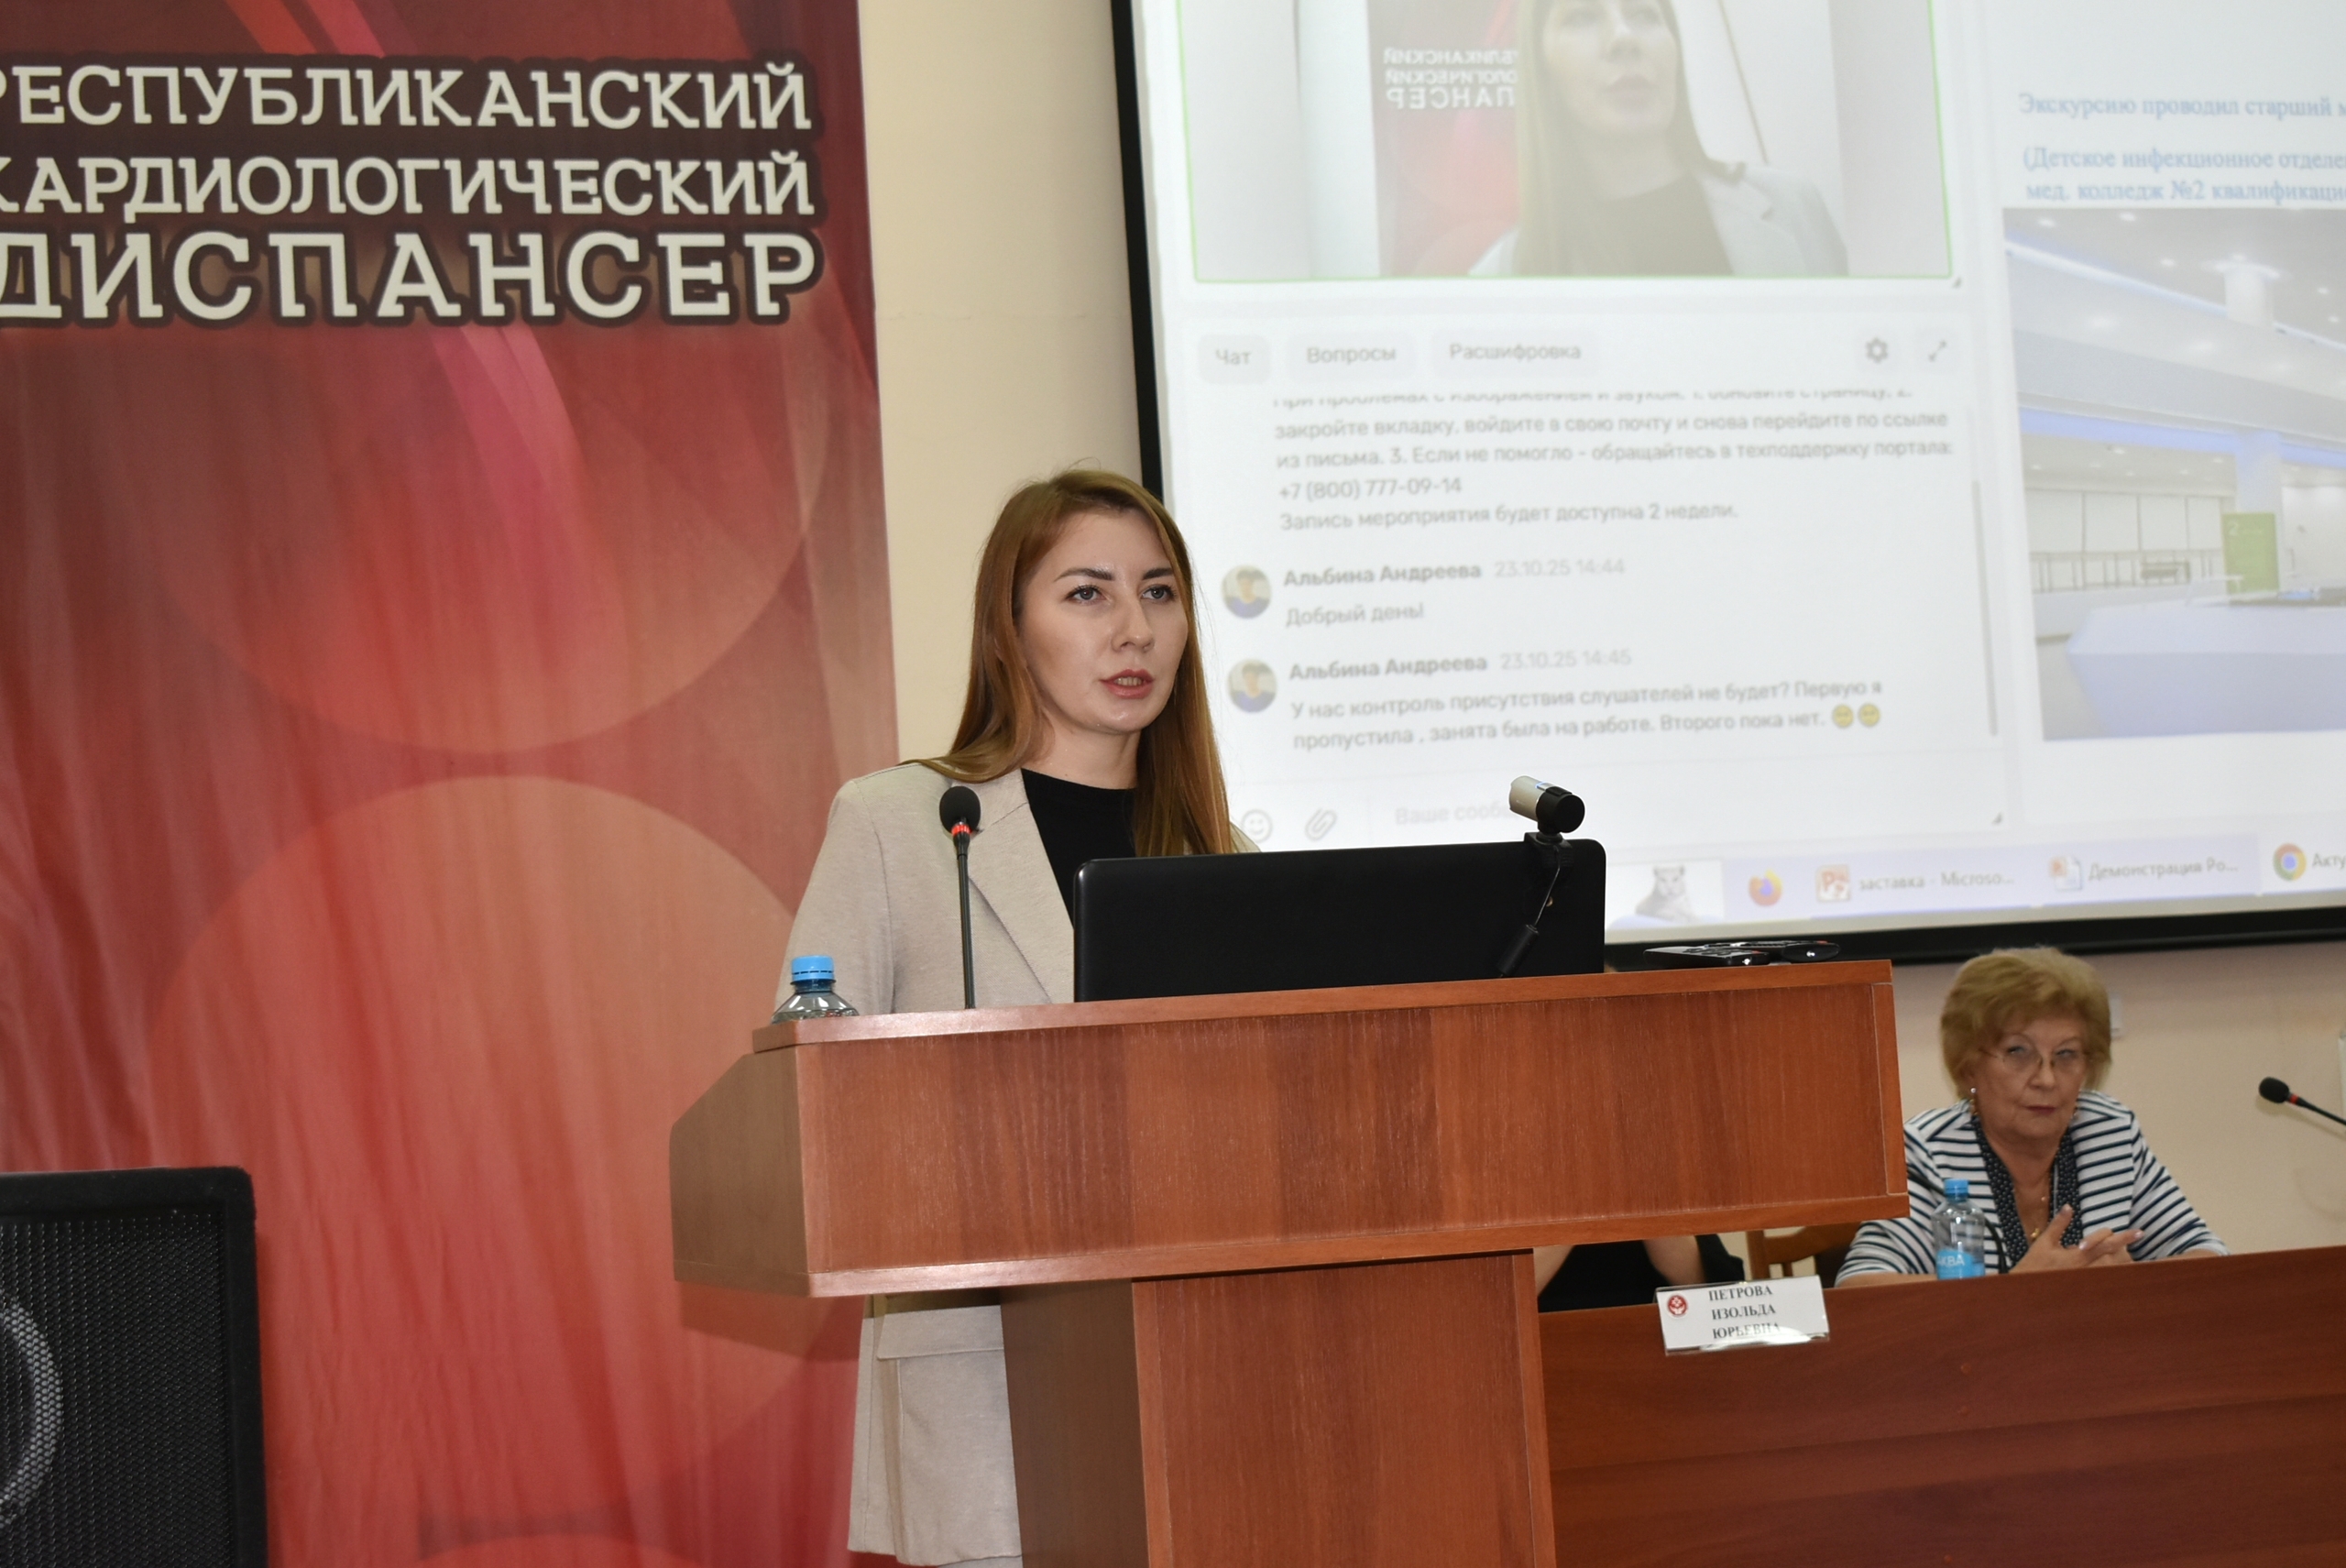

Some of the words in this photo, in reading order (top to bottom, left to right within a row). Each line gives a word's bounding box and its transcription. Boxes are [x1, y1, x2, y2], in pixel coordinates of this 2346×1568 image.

[0, 62, 812, 130] ЕСПУБЛИКАНСКИЙ
[2019, 93, 2136, 119] Экскурсию
[2142, 98, 2239, 120] проводил
[2245, 96, 2332, 121] старший
[2023, 147, 2115, 172] (Детское
[2122, 148, 2273, 173] инфекционное
[2279, 151, 2346, 170] отделе
[2026, 184, 2070, 201] мед.
[2077, 184, 2164, 201] колледж
[2171, 179, 2205, 200] №2
[0, 231, 815, 321] ДИСПАНСЕР
[1215, 349, 1251, 366] Чат
[1307, 346, 1397, 365] Вопросы
[1450, 343, 1582, 362] Расшифровка
[1276, 419, 1368, 441] закройте
[1465, 415, 1544, 435] войдите
[1550, 419, 1561, 432] в
[1564, 418, 1613, 432] свою
[1618, 417, 1672, 434] почту
[1677, 417, 1688, 430] и
[1694, 416, 1748, 431] снова
[1753, 411, 1852, 432] перейдите
[1858, 414, 1878, 428] по
[1883, 412, 1948, 428] ссылке
[1277, 455, 1299, 468] из
[1305, 451, 1384, 468] письма.
[1390, 447, 1408, 465] 3.
[1412, 446, 1460, 464] Если
[1465, 448, 1487, 462] не
[1494, 446, 1573, 462] помогло
[1592, 443, 1716, 462] обращайтесь
[1720, 445, 1731, 458] в
[1737, 444, 1869, 460] техподдержку
[1278, 484, 1300, 499] +7
[1306, 480, 1362, 501] (800)
[1365, 477, 1463, 496] 777-09-14
[1280, 511, 1354, 532] Запись
[1358, 508, 1490, 530] мероприятия
[1496, 504, 1550, 525] будет
[1556, 503, 1644, 523] доступна
[1649, 503, 1661, 520] 2
[1665, 503, 1738, 521] недели.
[1284, 569, 1375, 587] Альбина
[1380, 563, 1482, 585] Андреева
[1494, 560, 1571, 578] 23.10.25
[1576, 558, 1626, 576] 14:44
[1286, 605, 1365, 629] Добрый
[1289, 663, 1380, 681] Альбина
[1385, 655, 1487, 677] Андреева
[1500, 652, 1577, 671] 23.10.25
[1583, 649, 1632, 666] 14:45
[1291, 702, 1304, 719] У
[1310, 704, 1344, 718] нас
[1351, 696, 1445, 716] контроль
[1450, 692, 1574, 712] присутствия
[1580, 684, 1694, 706] слушателей
[1699, 686, 1720, 701] не
[1726, 680, 1789, 702] будет?
[1795, 681, 1867, 700] Первую
[1872, 682, 1882, 695] я
[1294, 728, 1413, 751] пропустила
[1429, 727, 1496, 743] занята
[1502, 721, 1550, 740] была
[1555, 722, 1578, 736] на
[1584, 715, 1655, 737] работе.
[1661, 713, 1735, 732] Второго
[1740, 715, 1783, 729] пока
[1788, 713, 1825, 729] нет.
[2088, 862, 2202, 880] Демонстрация
[1708, 1285, 1773, 1301] ПЕТРОВА
[1711, 1304, 1776, 1321] ИЗОЛЬДА
